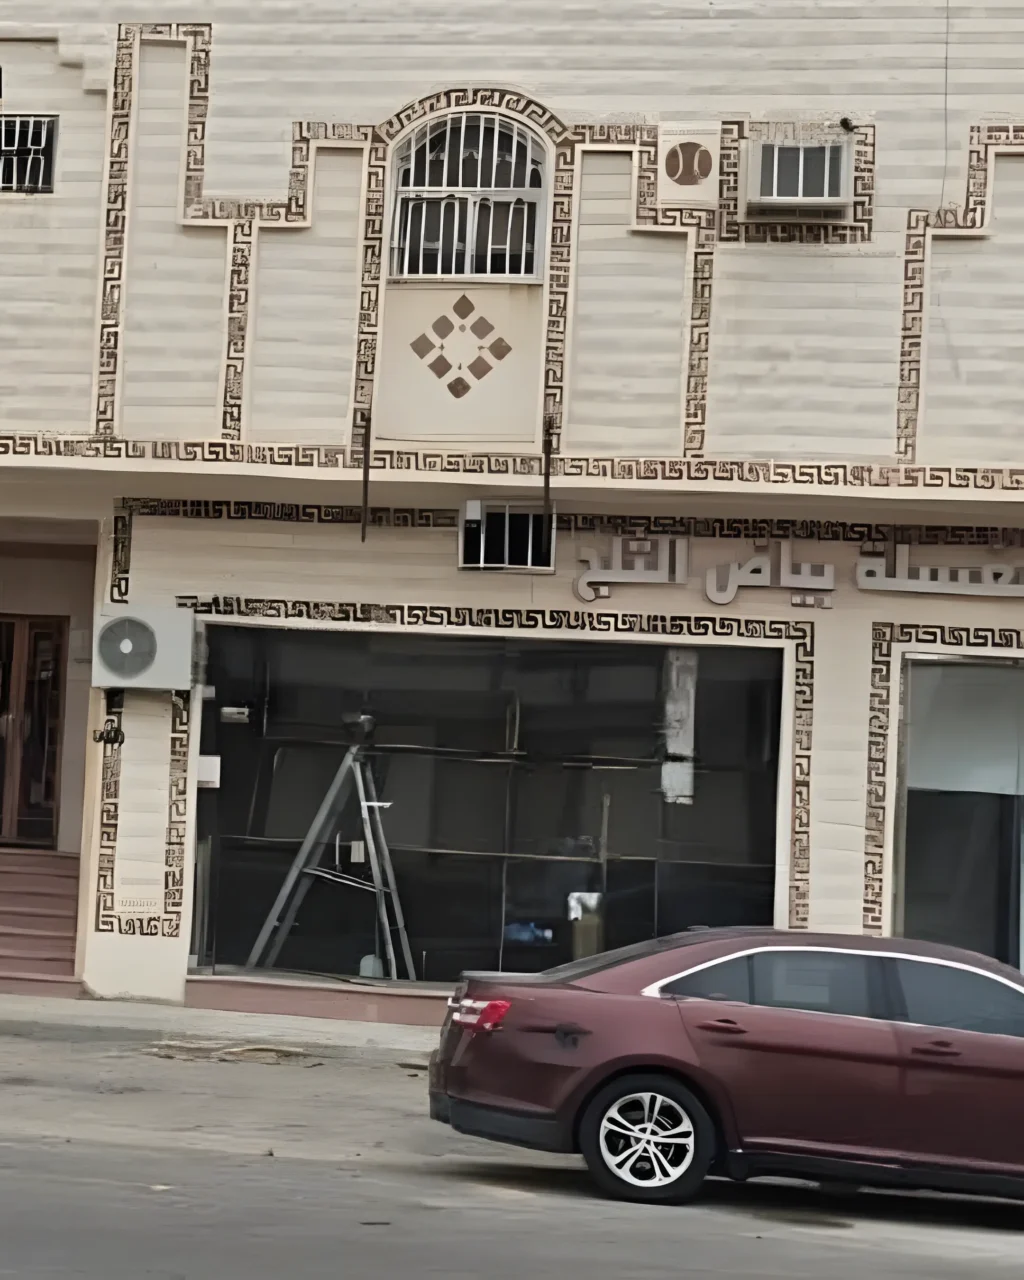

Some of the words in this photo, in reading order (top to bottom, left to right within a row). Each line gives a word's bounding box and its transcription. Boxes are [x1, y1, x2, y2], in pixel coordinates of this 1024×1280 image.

[575, 526, 688, 602] الثلج
[705, 539, 836, 608] بياض
[856, 541, 1024, 597] غسلة
